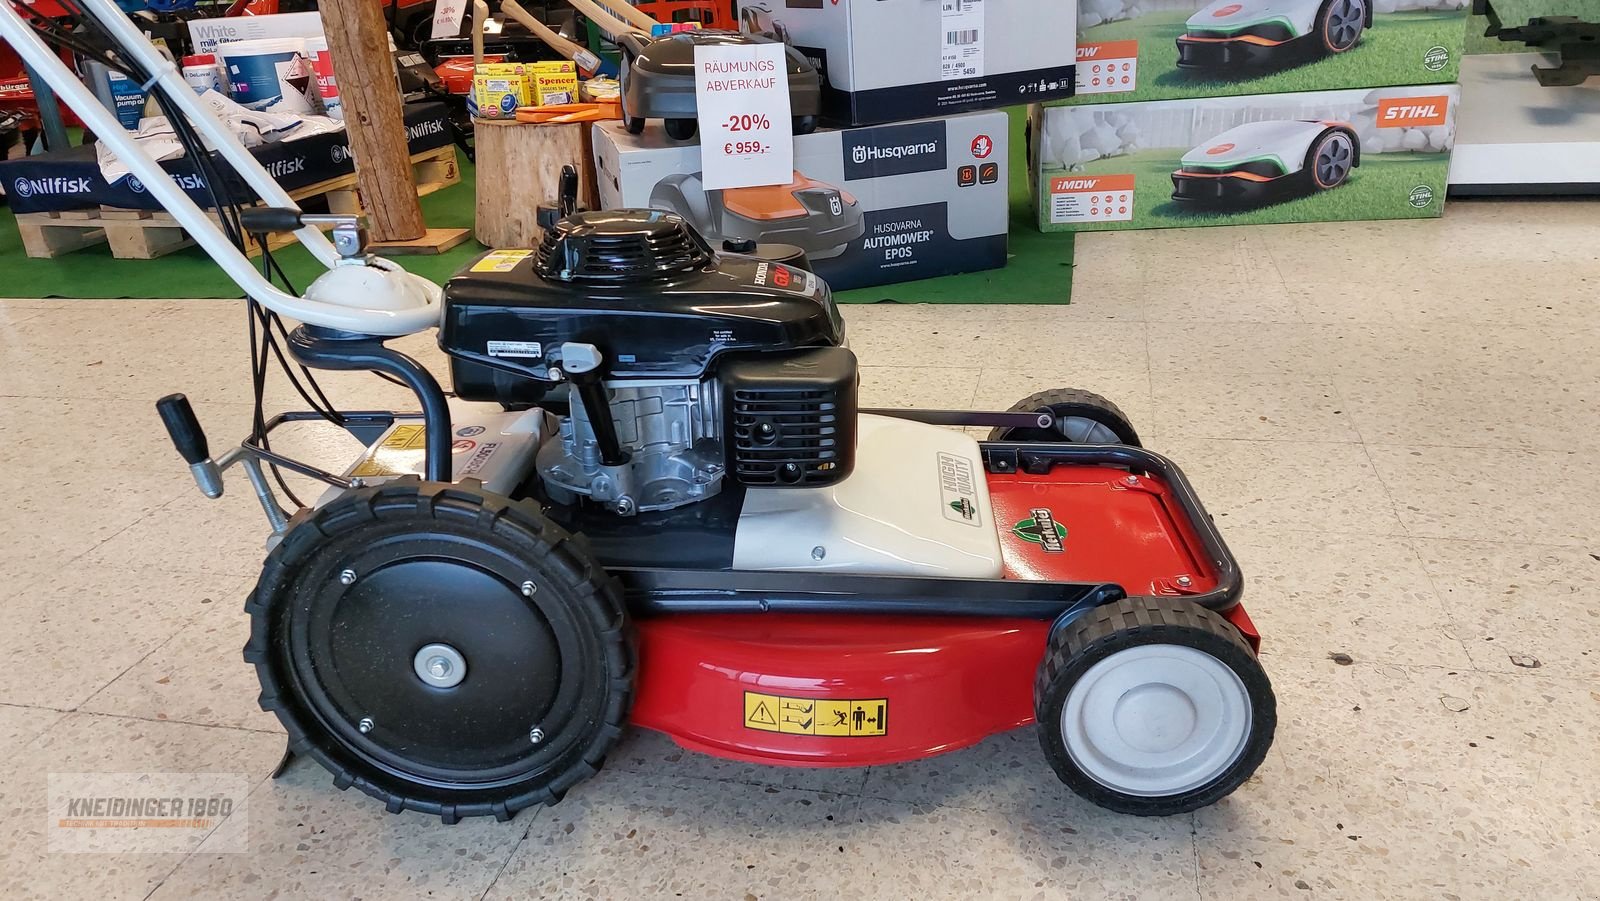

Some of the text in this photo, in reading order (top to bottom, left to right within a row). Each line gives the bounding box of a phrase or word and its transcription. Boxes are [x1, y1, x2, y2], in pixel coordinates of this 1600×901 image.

[195, 25, 236, 38] White
[200, 38, 218, 47] milk
[1076, 46, 1098, 58] OW
[1425, 53, 1448, 64] STIHL
[704, 60, 775, 74] RÄUMUNGS
[538, 77, 575, 87] Spencer
[706, 78, 776, 92] ABVERKAUF
[115, 94, 142, 102] Vacuum
[117, 99, 137, 108] pump
[1384, 105, 1439, 120] STIHL
[410, 119, 444, 140] Nilfisk
[721, 114, 770, 132] -20%
[724, 141, 770, 154] € 959,-
[867, 141, 937, 160] Husqvarna
[266, 157, 305, 178] ilfisk
[30, 177, 92, 195] Nilfisk
[1056, 179, 1097, 191] iMOW
[1410, 192, 1432, 202] STIHL
[873, 219, 922, 234] HUSQVARNA
[885, 246, 912, 260] EPOS
[754, 262, 769, 286] HONDA
[773, 264, 790, 287] GXV
[940, 455, 958, 493] HIGH
[955, 457, 975, 496] QUALITY
[1033, 508, 1064, 552] Herkules
